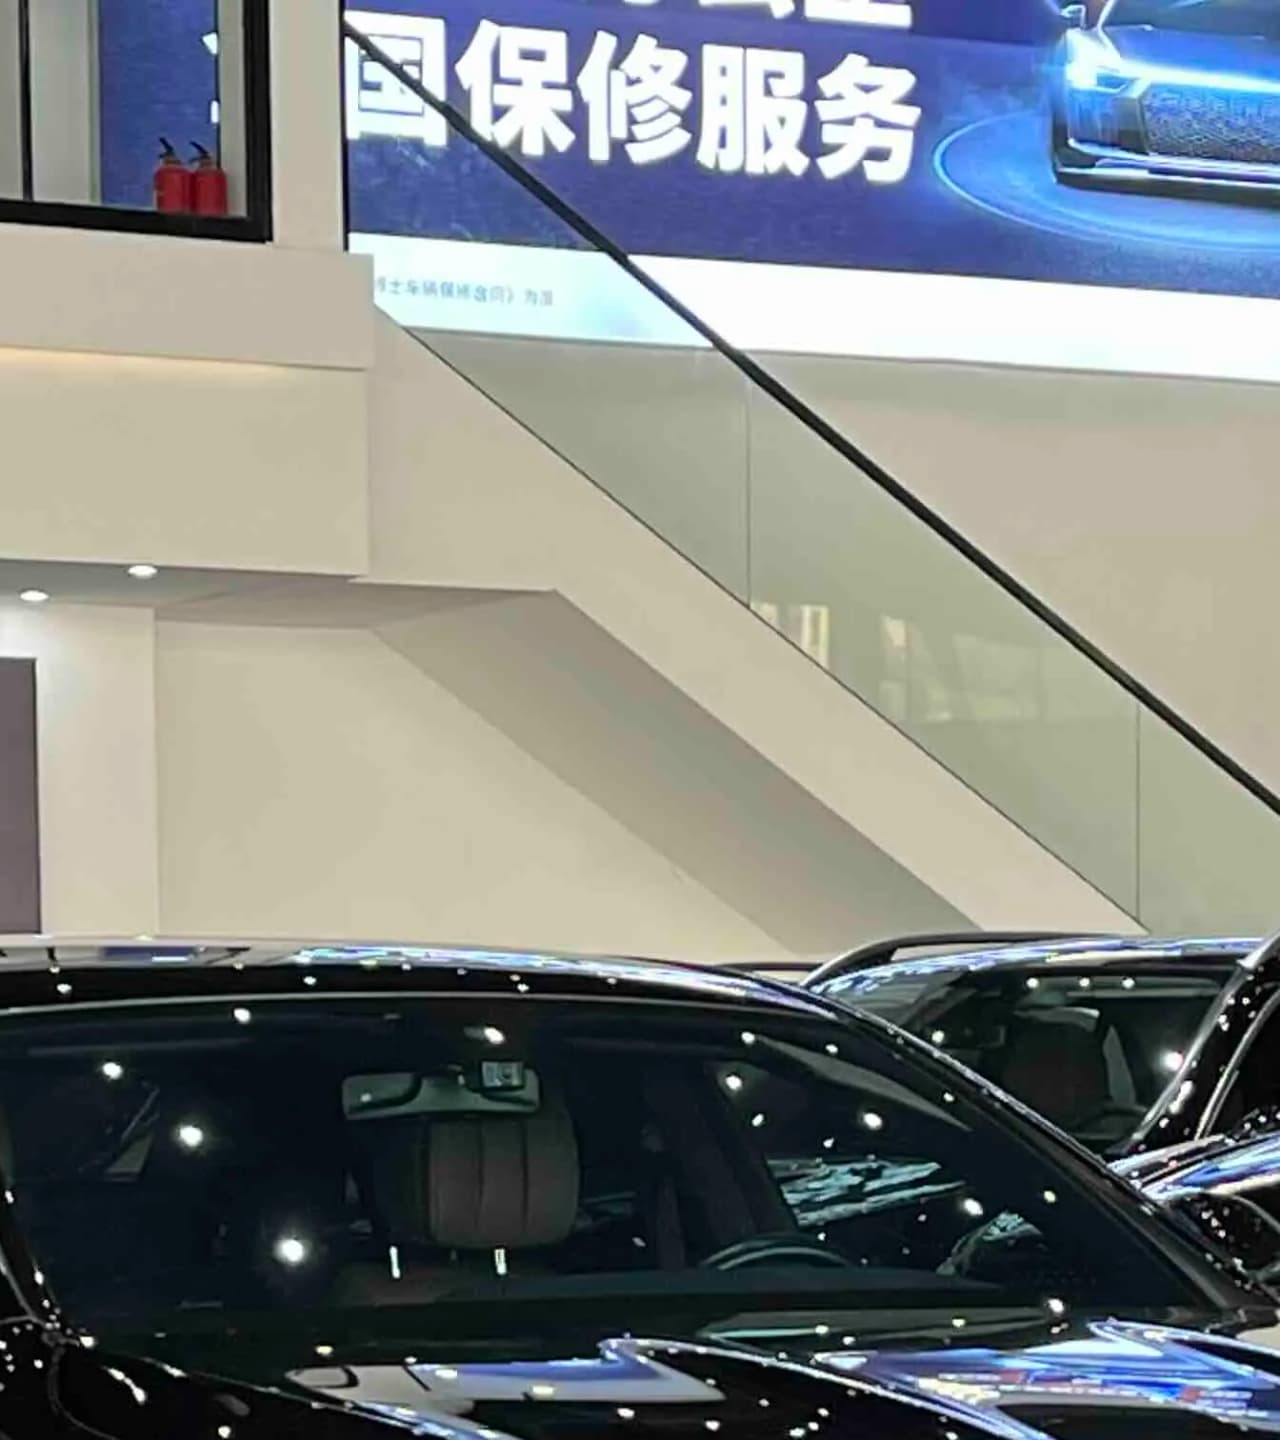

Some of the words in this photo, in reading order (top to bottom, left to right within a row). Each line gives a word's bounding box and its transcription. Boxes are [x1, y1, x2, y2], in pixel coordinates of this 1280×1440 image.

[345, 11, 922, 184] 国保修服务
